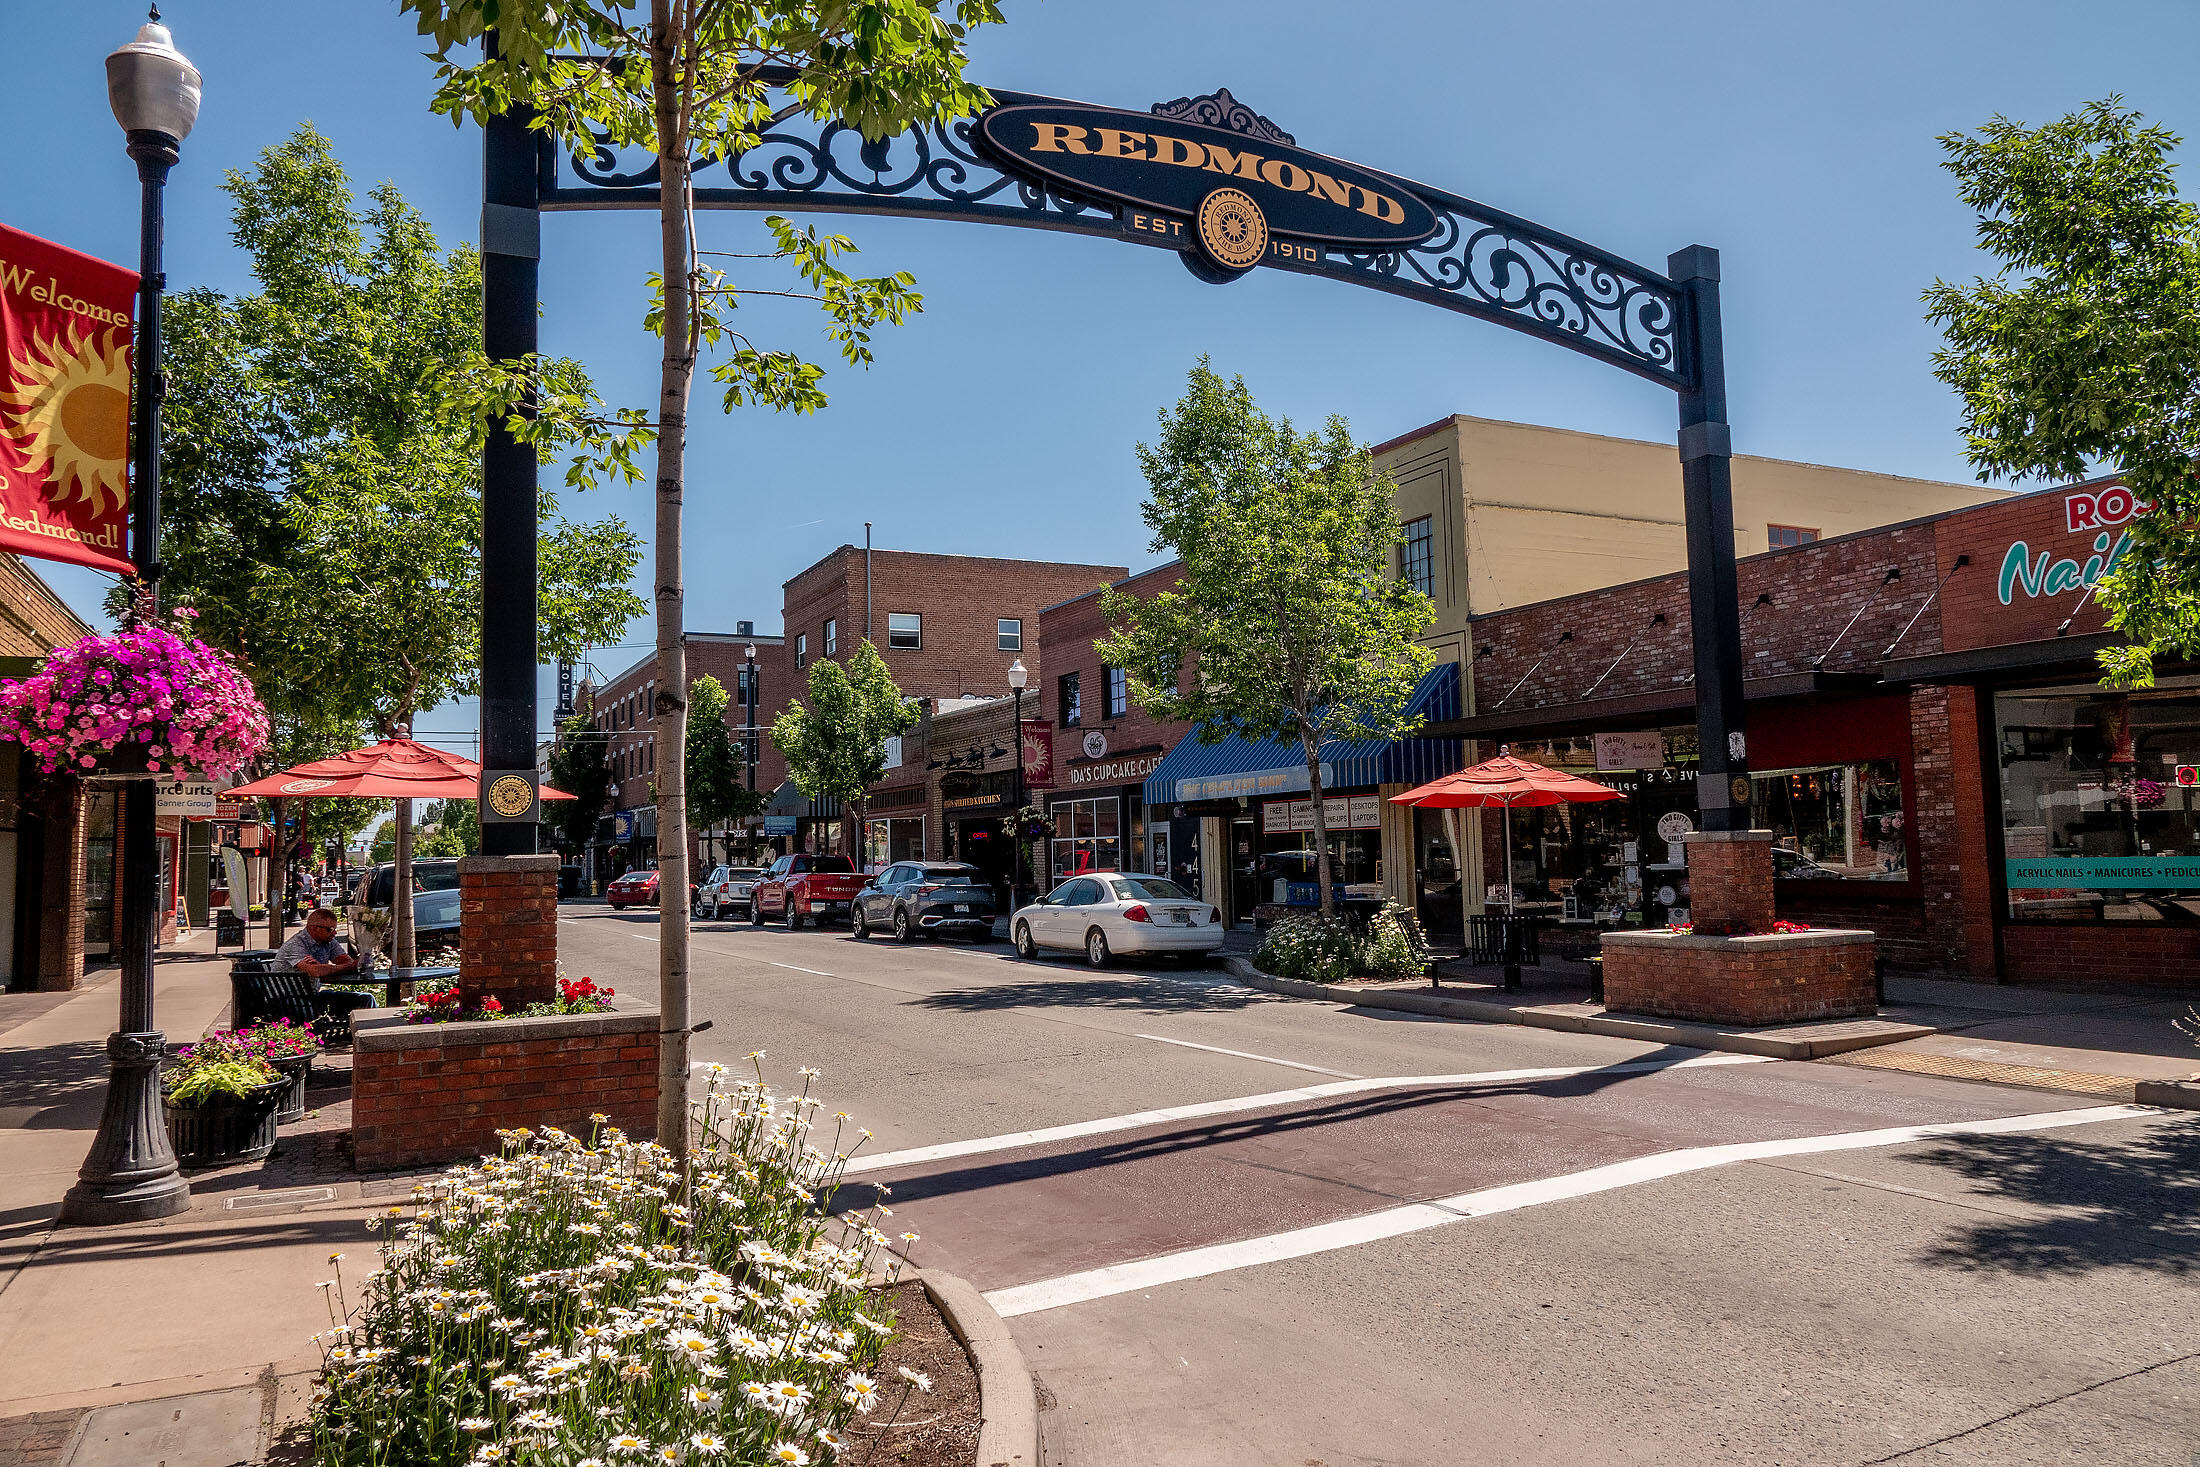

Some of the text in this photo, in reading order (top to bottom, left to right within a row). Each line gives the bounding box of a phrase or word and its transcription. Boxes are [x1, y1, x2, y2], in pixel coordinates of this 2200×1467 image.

[1029, 121, 1406, 226] REDMOND
[1215, 203, 1252, 225] REDMOND
[1133, 214, 1318, 263] EST 1910
[1217, 234, 1252, 252] THE HUB
[0, 259, 130, 328] Welcome
[561, 663, 570, 710] HOTEL
[1024, 725, 1051, 733] Welcome
[1070, 766, 1091, 784] IDA'S
[1094, 760, 1136, 781] CUPCAKE
[155, 785, 213, 796] arcourts
[186, 800, 212, 809] Group
[974, 794, 1001, 806] KITCHEN
[1350, 801, 1379, 811] DESKTOPS
[1269, 806, 1283, 815] FREE
[1292, 804, 1313, 813] GAMING
[1323, 803, 1345, 812] REPAIRS
[1352, 812, 1378, 822] LAPTOPS
[1661, 813, 1688, 825] TWO GIFTY
[1265, 821, 1289, 829] DIAGNOSTIC
[2016, 867, 2055, 879] ACRYLIC
[2056, 867, 2084, 879] NAILS
[2094, 866, 2153, 878] MANICURES
